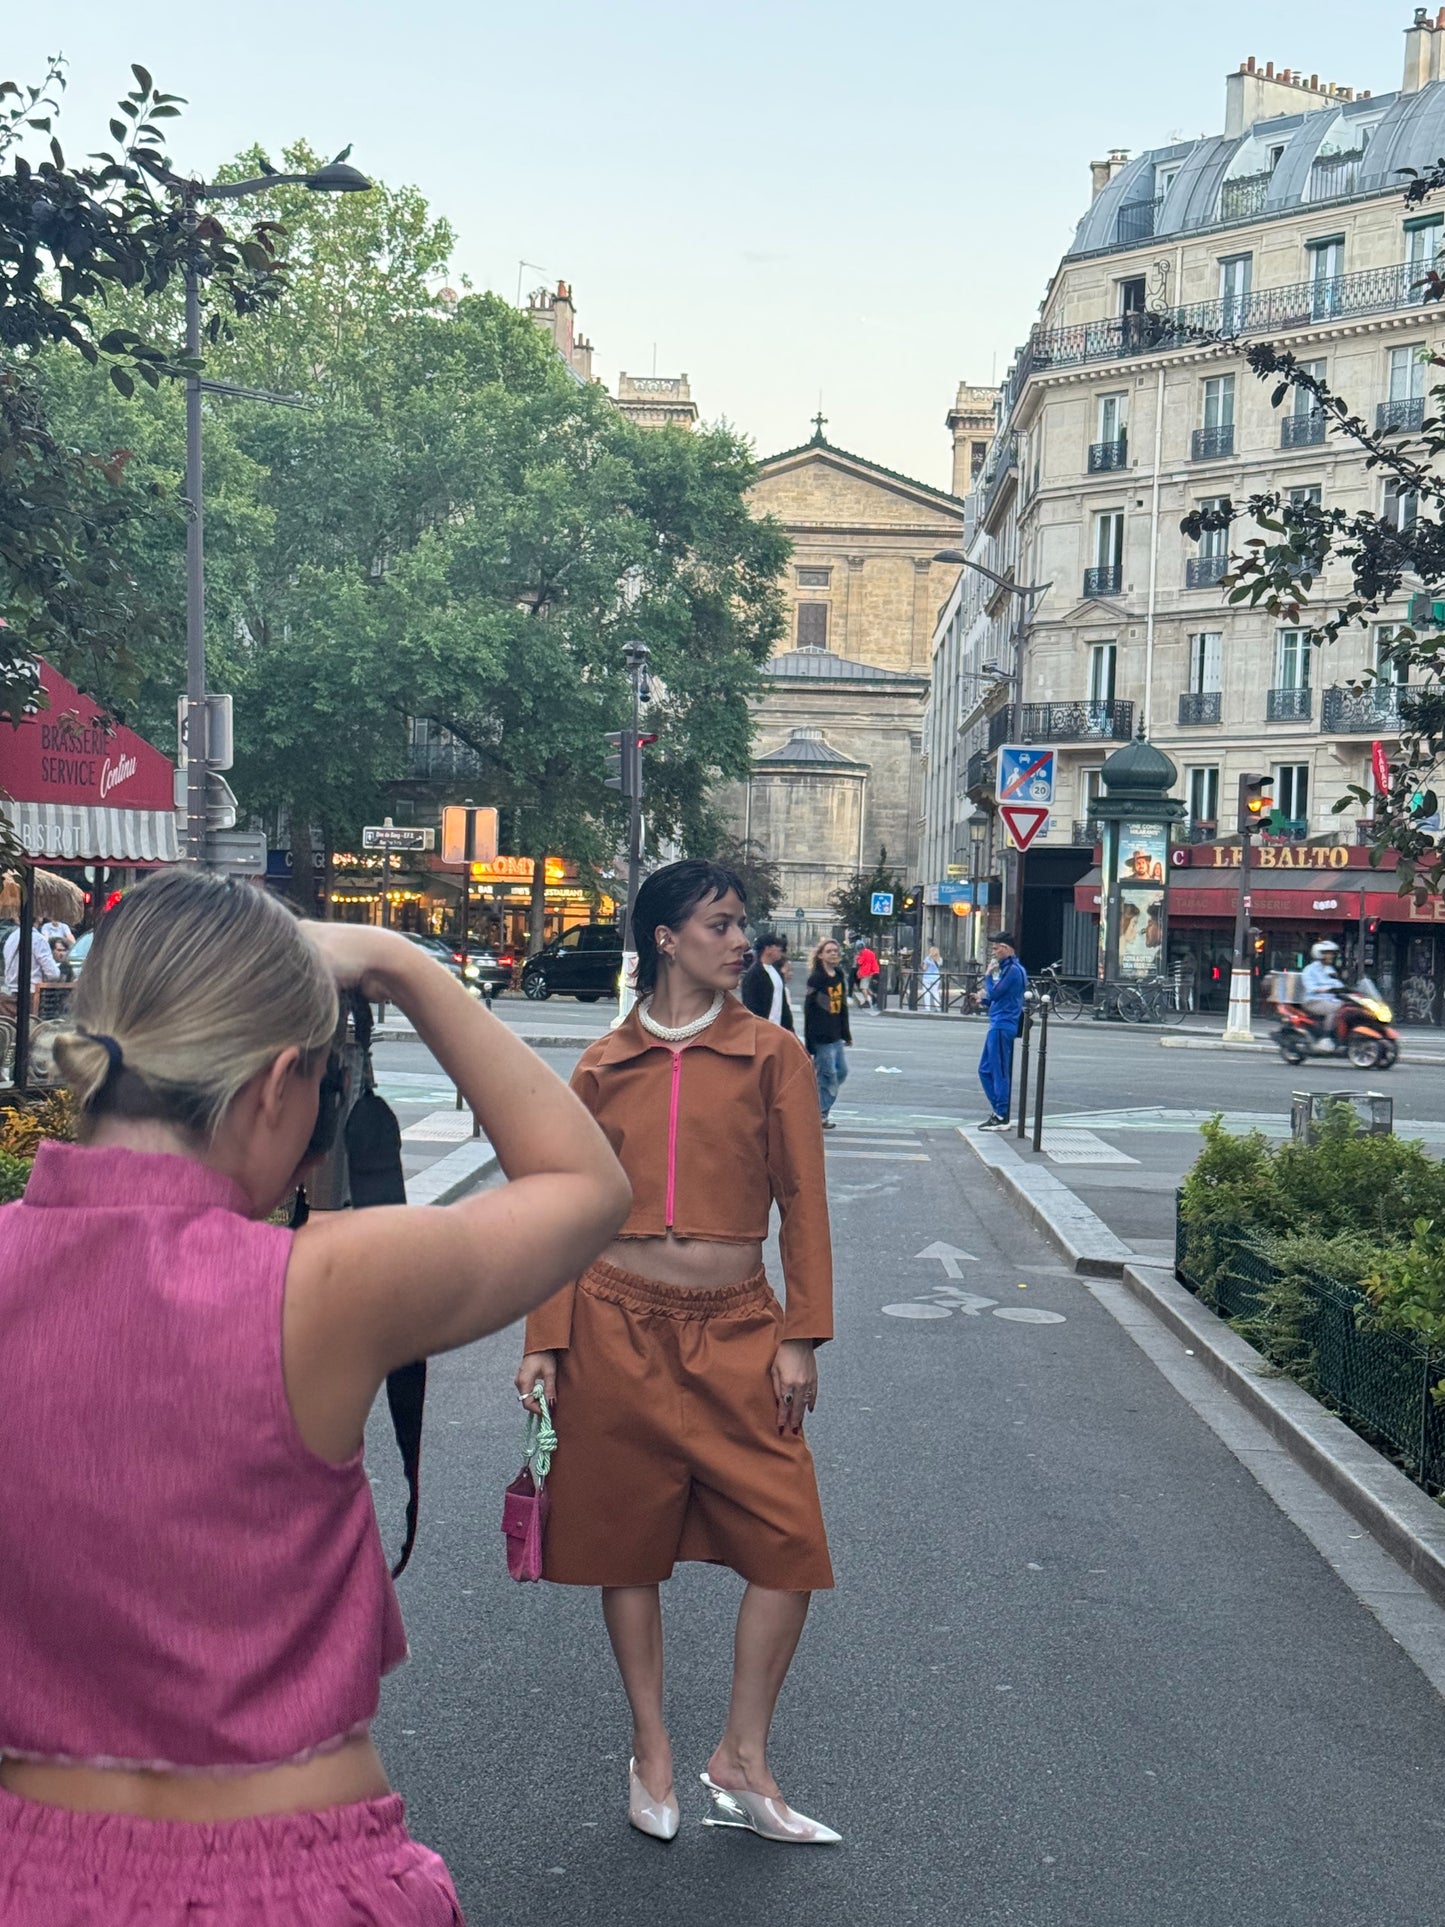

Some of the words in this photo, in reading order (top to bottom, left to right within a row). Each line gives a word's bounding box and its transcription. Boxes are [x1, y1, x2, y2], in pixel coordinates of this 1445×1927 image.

[41, 724, 110, 756] BRASSERIE
[41, 756, 96, 786] SERVICE
[100, 752, 137, 799] Continu
[1377, 749, 1388, 789] TABAC
[1034, 786, 1046, 795] 20
[22, 823, 81, 851] BISTROT
[1258, 846, 1349, 868] BALTO
